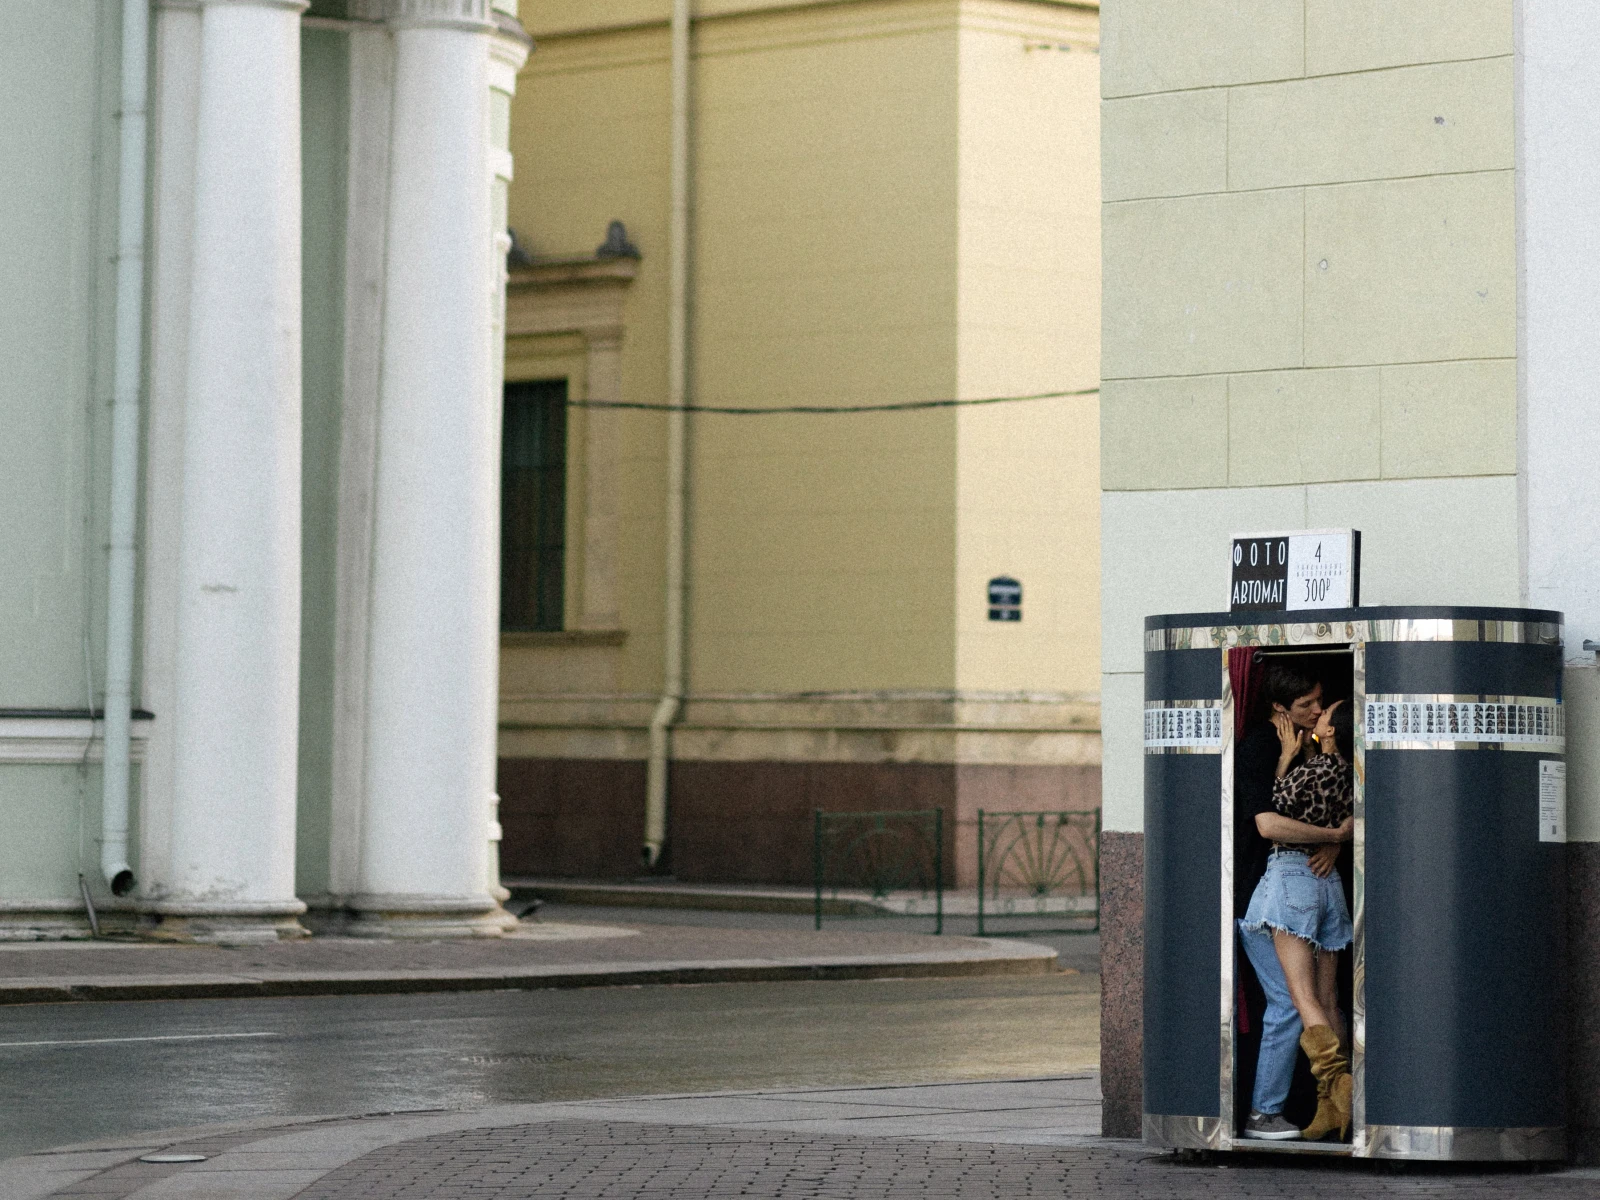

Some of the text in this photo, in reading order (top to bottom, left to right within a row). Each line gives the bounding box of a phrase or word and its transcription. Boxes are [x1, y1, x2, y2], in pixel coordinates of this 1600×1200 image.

[1233, 541, 1286, 566] ФОТО
[1314, 541, 1322, 563] 4
[1232, 579, 1285, 604] АВТОМАТ
